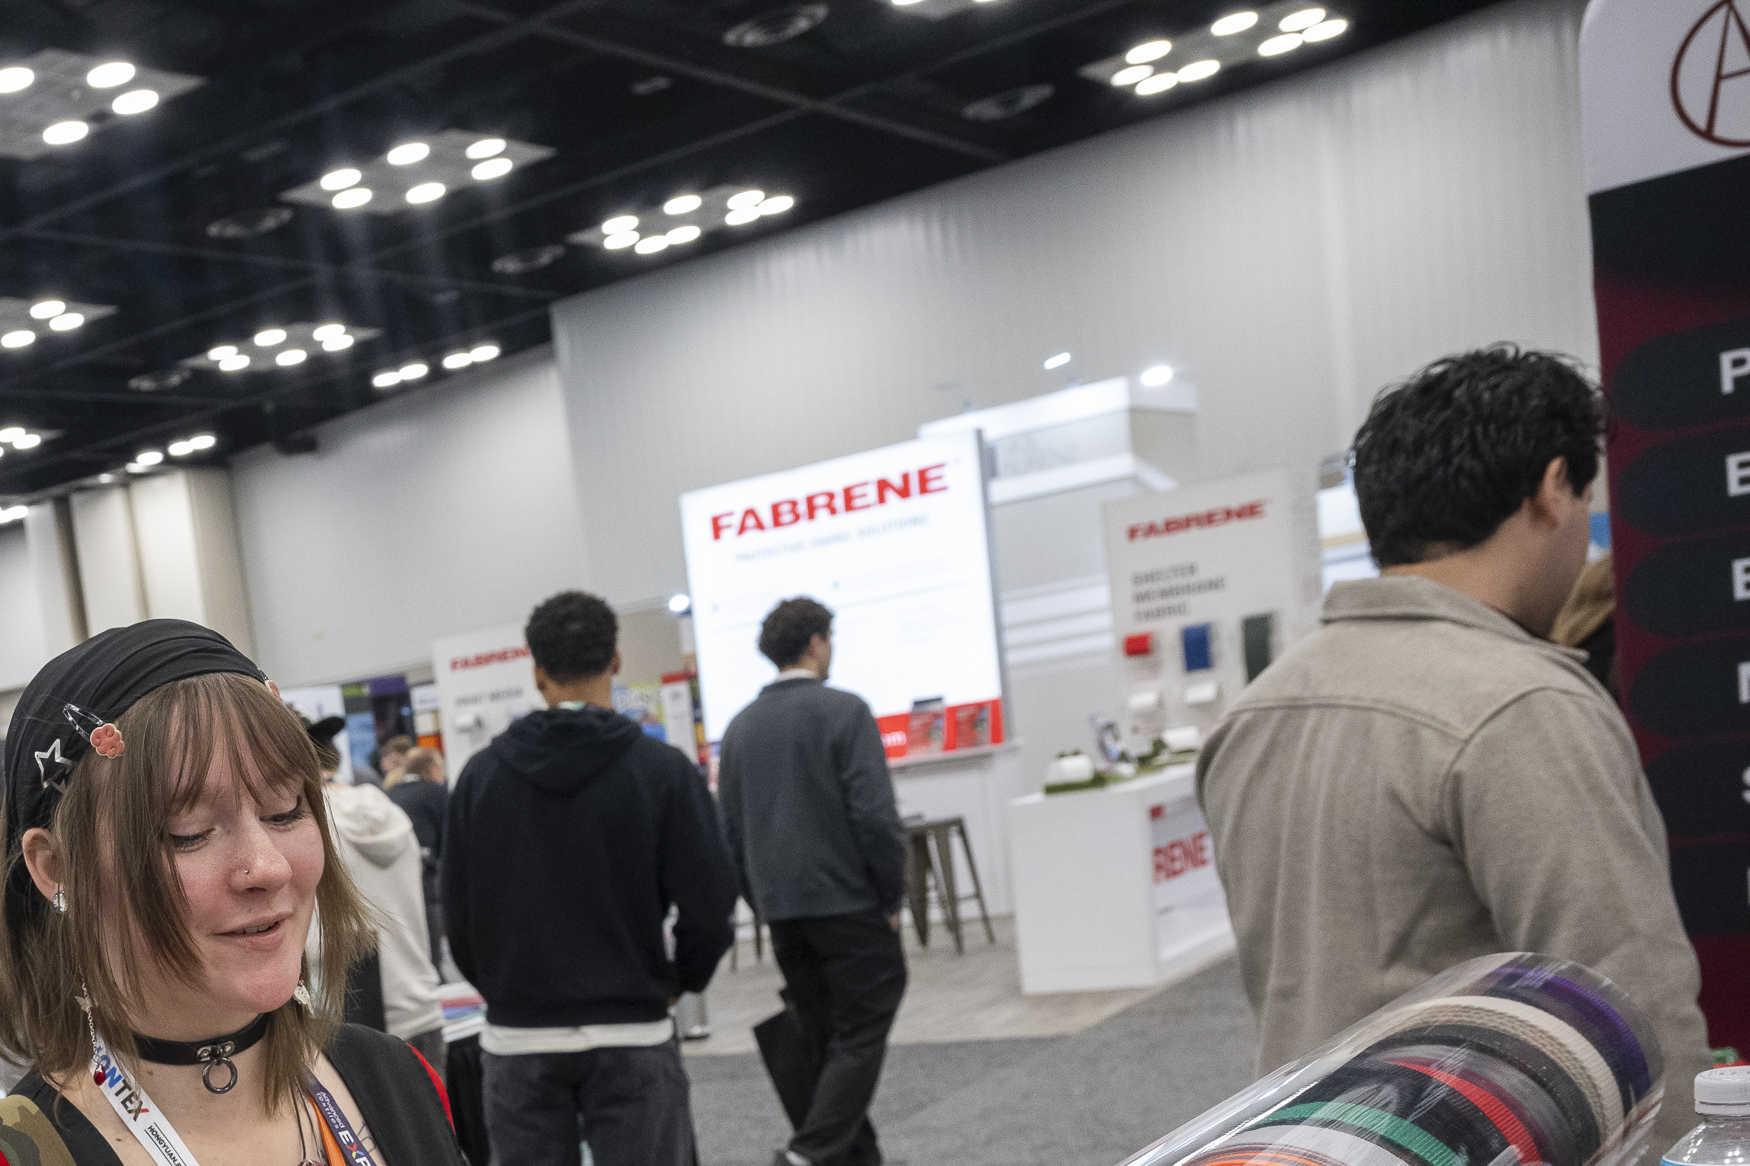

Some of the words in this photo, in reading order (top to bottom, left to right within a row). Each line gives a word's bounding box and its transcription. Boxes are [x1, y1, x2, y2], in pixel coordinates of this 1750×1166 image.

[711, 463, 949, 540] FABRENE
[1126, 499, 1268, 542] FABRENE
[450, 646, 532, 673] FABREN
[95, 1047, 150, 1122] ONTEX
[316, 1092, 340, 1130] Textiles
[319, 1090, 346, 1129] Advanced
